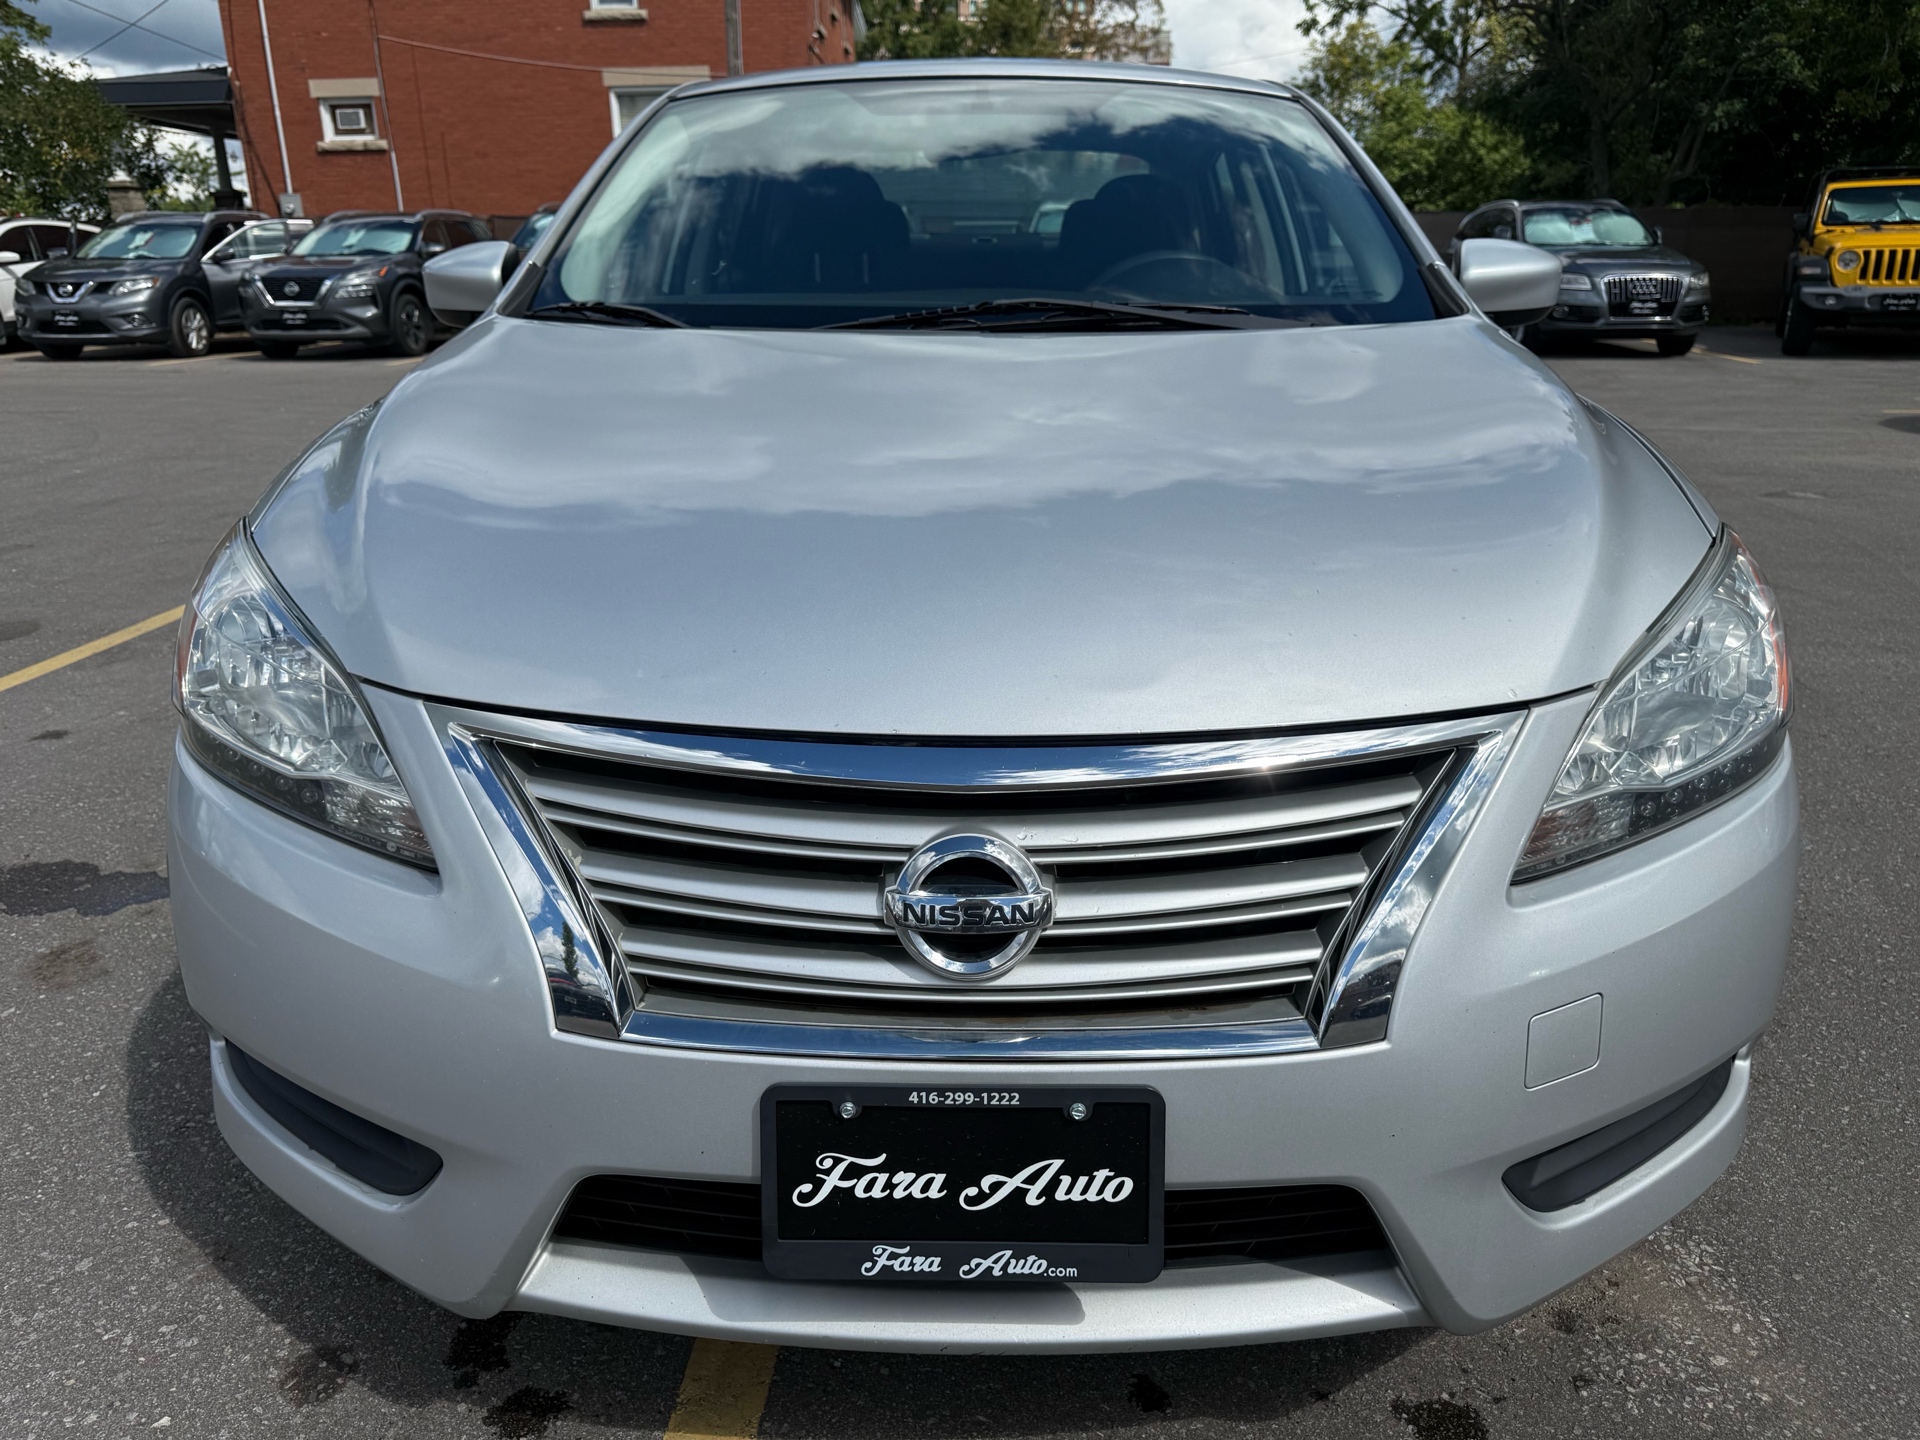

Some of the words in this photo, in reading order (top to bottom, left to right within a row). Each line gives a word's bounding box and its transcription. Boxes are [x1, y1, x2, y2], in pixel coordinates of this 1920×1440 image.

[902, 901, 1035, 927] NISSAN
[908, 1091, 1020, 1105] 416-299-1222
[792, 1152, 947, 1208] Fara
[958, 1158, 1134, 1211] Auto
[860, 1244, 942, 1277] Fara
